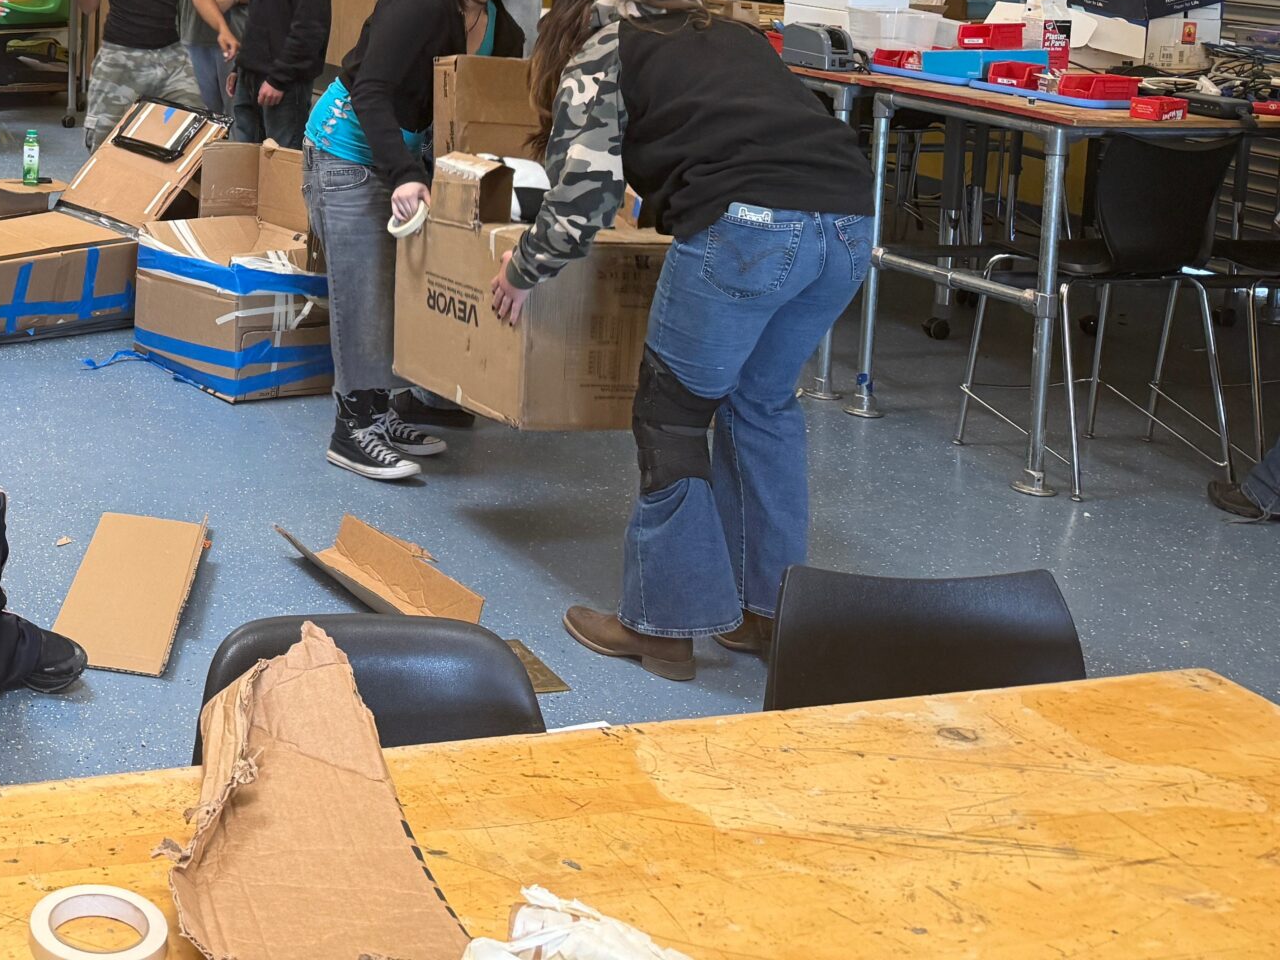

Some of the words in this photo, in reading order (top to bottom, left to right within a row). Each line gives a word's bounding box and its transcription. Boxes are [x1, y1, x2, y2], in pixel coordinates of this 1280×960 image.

[1044, 32, 1066, 40] Plaster
[1051, 39, 1065, 47] Paris
[427, 287, 480, 328] VEVOR
